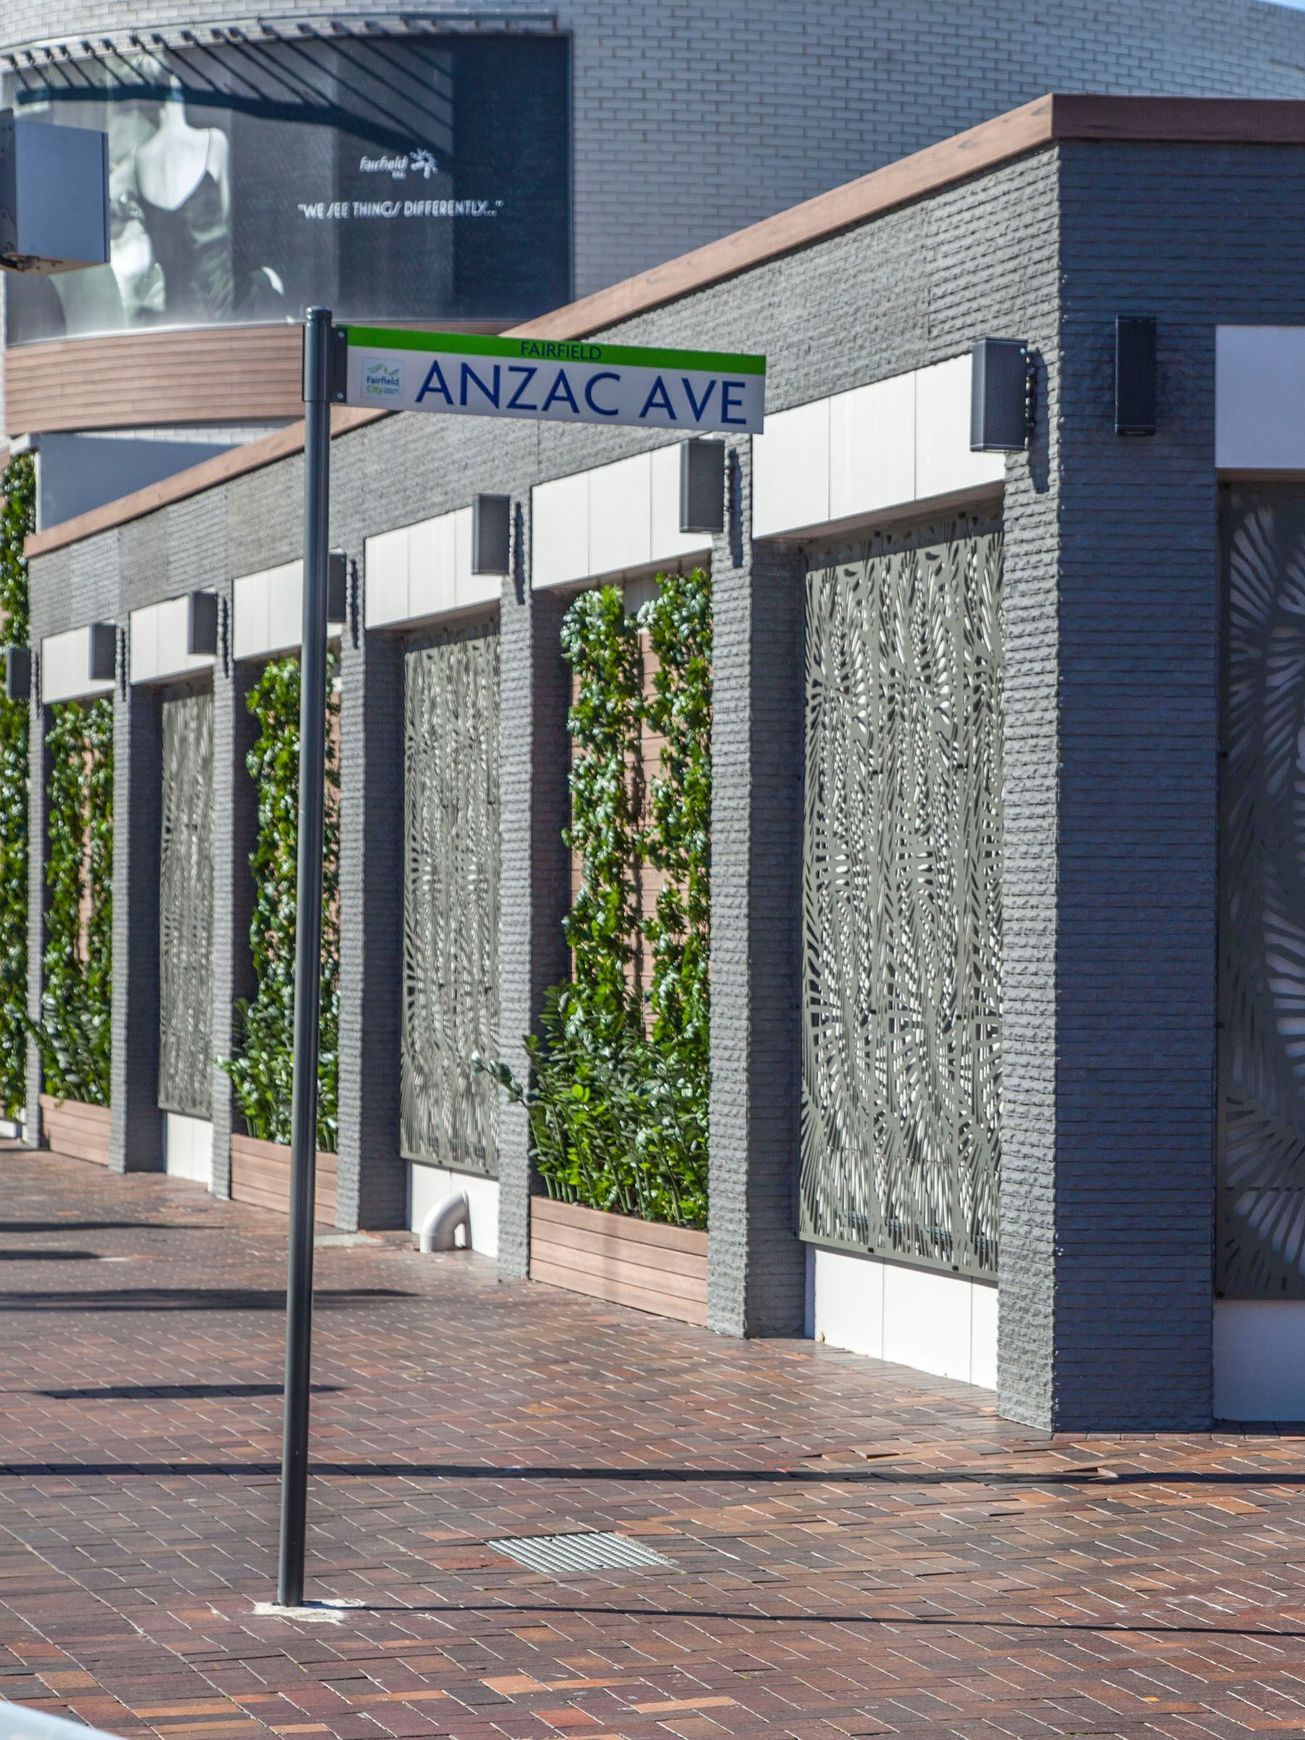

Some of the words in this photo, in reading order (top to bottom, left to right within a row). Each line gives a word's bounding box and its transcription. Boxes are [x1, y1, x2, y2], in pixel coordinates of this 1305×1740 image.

[327, 202, 349, 218] SEE
[353, 201, 401, 218] THINGS
[520, 340, 601, 360] FAIRFIELD
[367, 375, 399, 385] Fairfield
[415, 359, 621, 416] ANZAC
[639, 375, 747, 425] AVE
